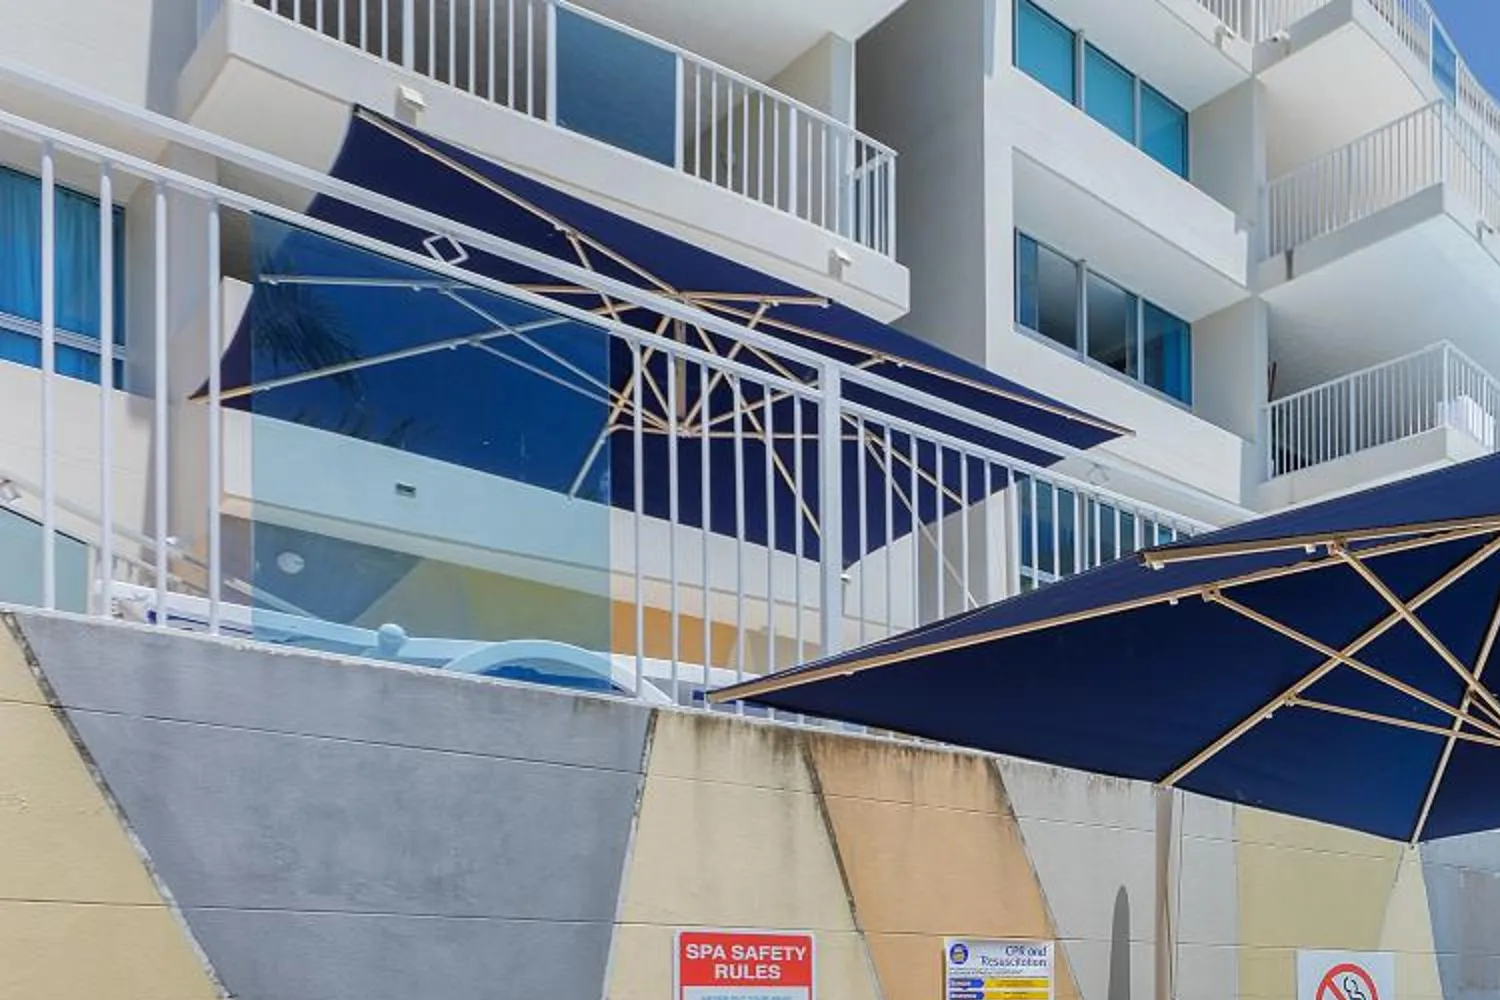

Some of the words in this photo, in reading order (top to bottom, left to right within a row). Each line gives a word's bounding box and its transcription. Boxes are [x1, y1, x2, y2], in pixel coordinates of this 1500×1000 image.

[685, 943, 727, 960] SPA
[731, 944, 807, 961] SAFETY
[1005, 945, 1025, 956] CPR
[1027, 945, 1048, 957] and
[714, 963, 782, 980] RULES
